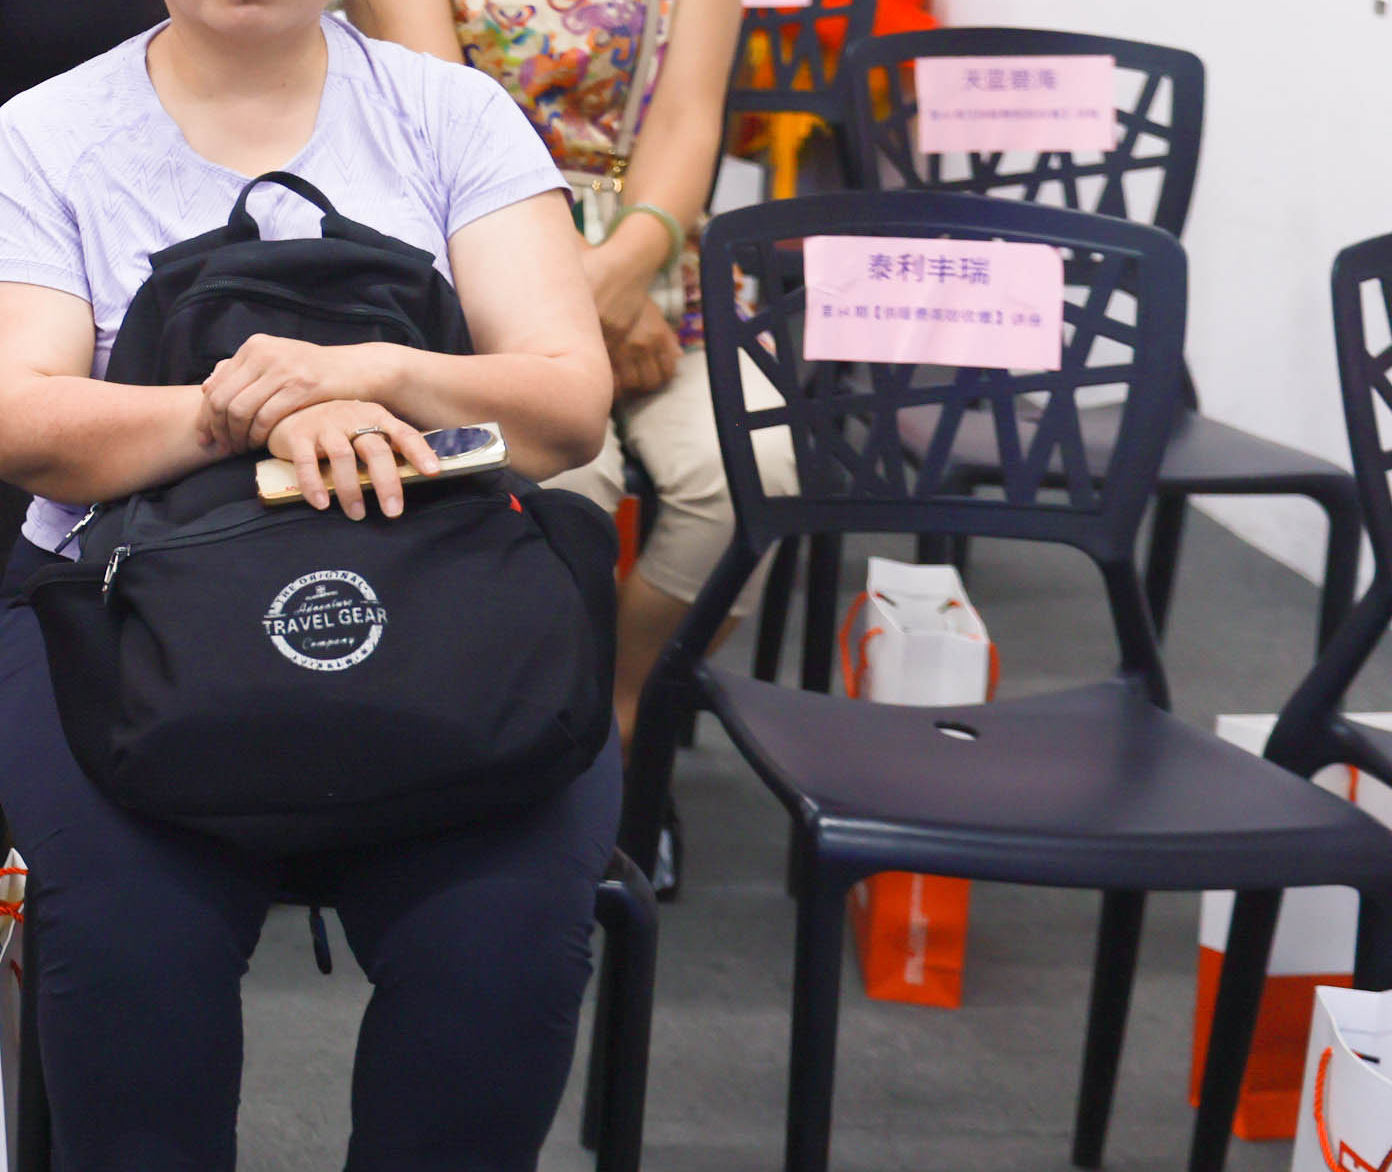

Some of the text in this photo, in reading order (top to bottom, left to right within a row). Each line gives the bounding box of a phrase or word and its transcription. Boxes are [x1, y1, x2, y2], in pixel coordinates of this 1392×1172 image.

[868, 253, 991, 285] 泰利丰瑞
[262, 607, 388, 635] TRAVEL GEAR
